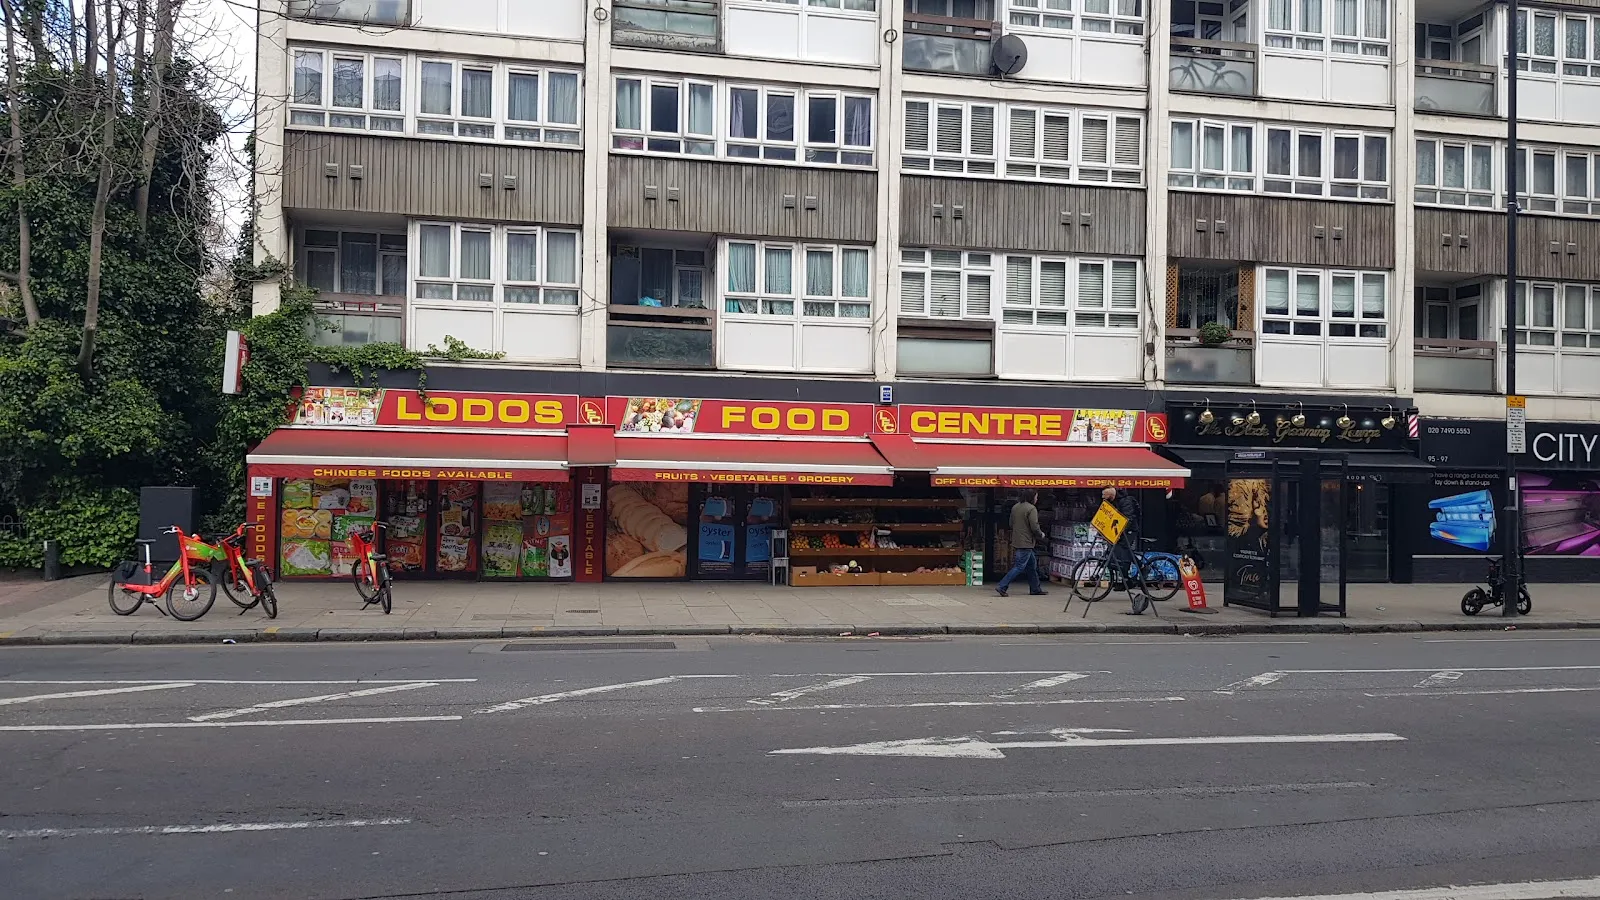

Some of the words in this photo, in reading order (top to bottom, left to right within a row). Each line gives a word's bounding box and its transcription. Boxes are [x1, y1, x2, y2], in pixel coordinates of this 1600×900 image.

[397, 396, 564, 424] LODOS
[721, 406, 850, 431] FOOD
[910, 411, 1062, 437] CENTRE
[1427, 426, 1439, 435] 020
[1440, 427, 1455, 435] 7490
[1456, 427, 1471, 436] 5553
[1533, 432, 1598, 463] CITY
[1427, 455, 1436, 463] 95
[1440, 455, 1449, 463] 97
[313, 468, 377, 477] CHINESE
[382, 470, 431, 478] FOODS
[437, 470, 513, 479] AVAILABLE
[655, 472, 698, 480] FRUITS
[710, 473, 787, 482] VEGETABLES
[798, 475, 854, 484] GROCERY
[1011, 479, 1077, 487] NEWSPAPER
[1086, 479, 1116, 487] OPEN
[255, 514, 266, 562] FOODS
